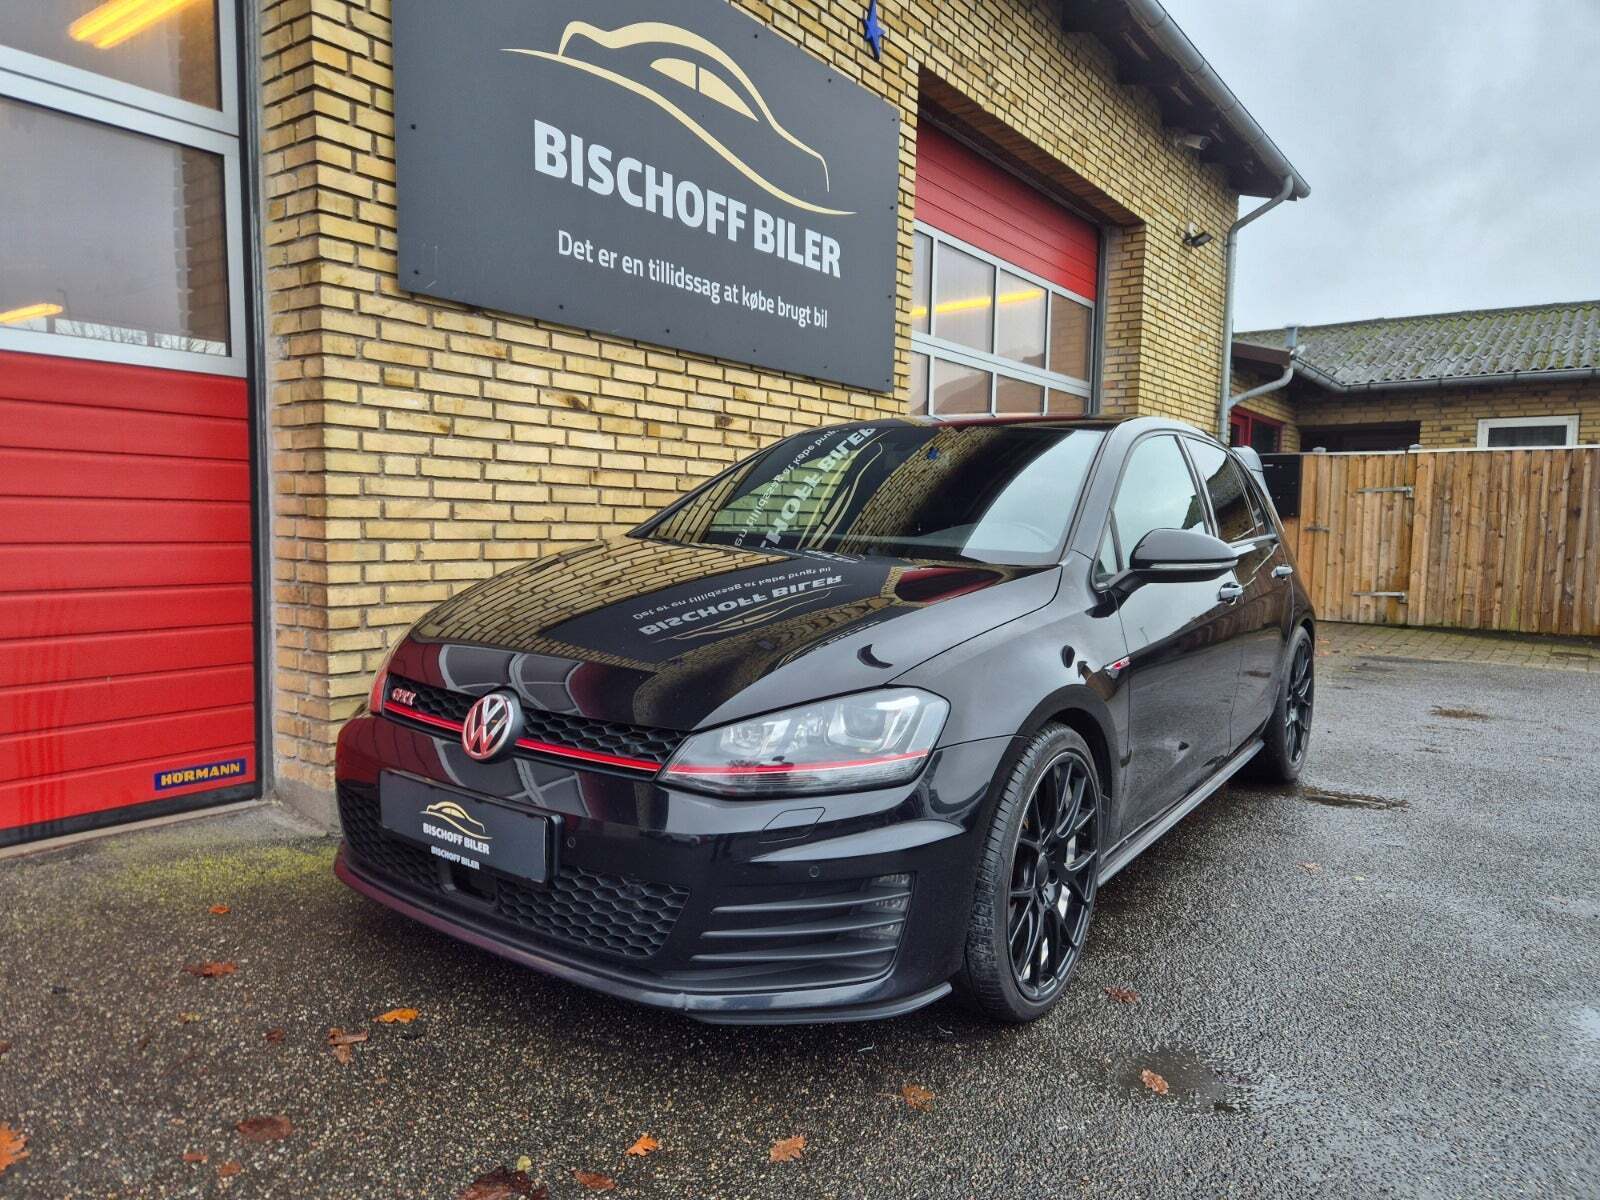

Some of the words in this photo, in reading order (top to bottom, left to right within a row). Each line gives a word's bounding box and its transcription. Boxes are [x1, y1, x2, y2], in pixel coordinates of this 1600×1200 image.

[534, 119, 747, 242] BISCHOFF
[753, 207, 841, 279] BILER
[558, 230, 594, 264] Det
[598, 248, 618, 270] er
[622, 255, 643, 277] en
[648, 259, 720, 305] tillidssag
[723, 284, 739, 302] at
[741, 285, 775, 316] købe
[778, 296, 812, 330] brugt
[813, 308, 828, 329] bil
[422, 822, 464, 847] BISCHOFF
[464, 836, 490, 856] BILER
[430, 845, 461, 864] BISCHOFF
[460, 856, 480, 871] BILER
